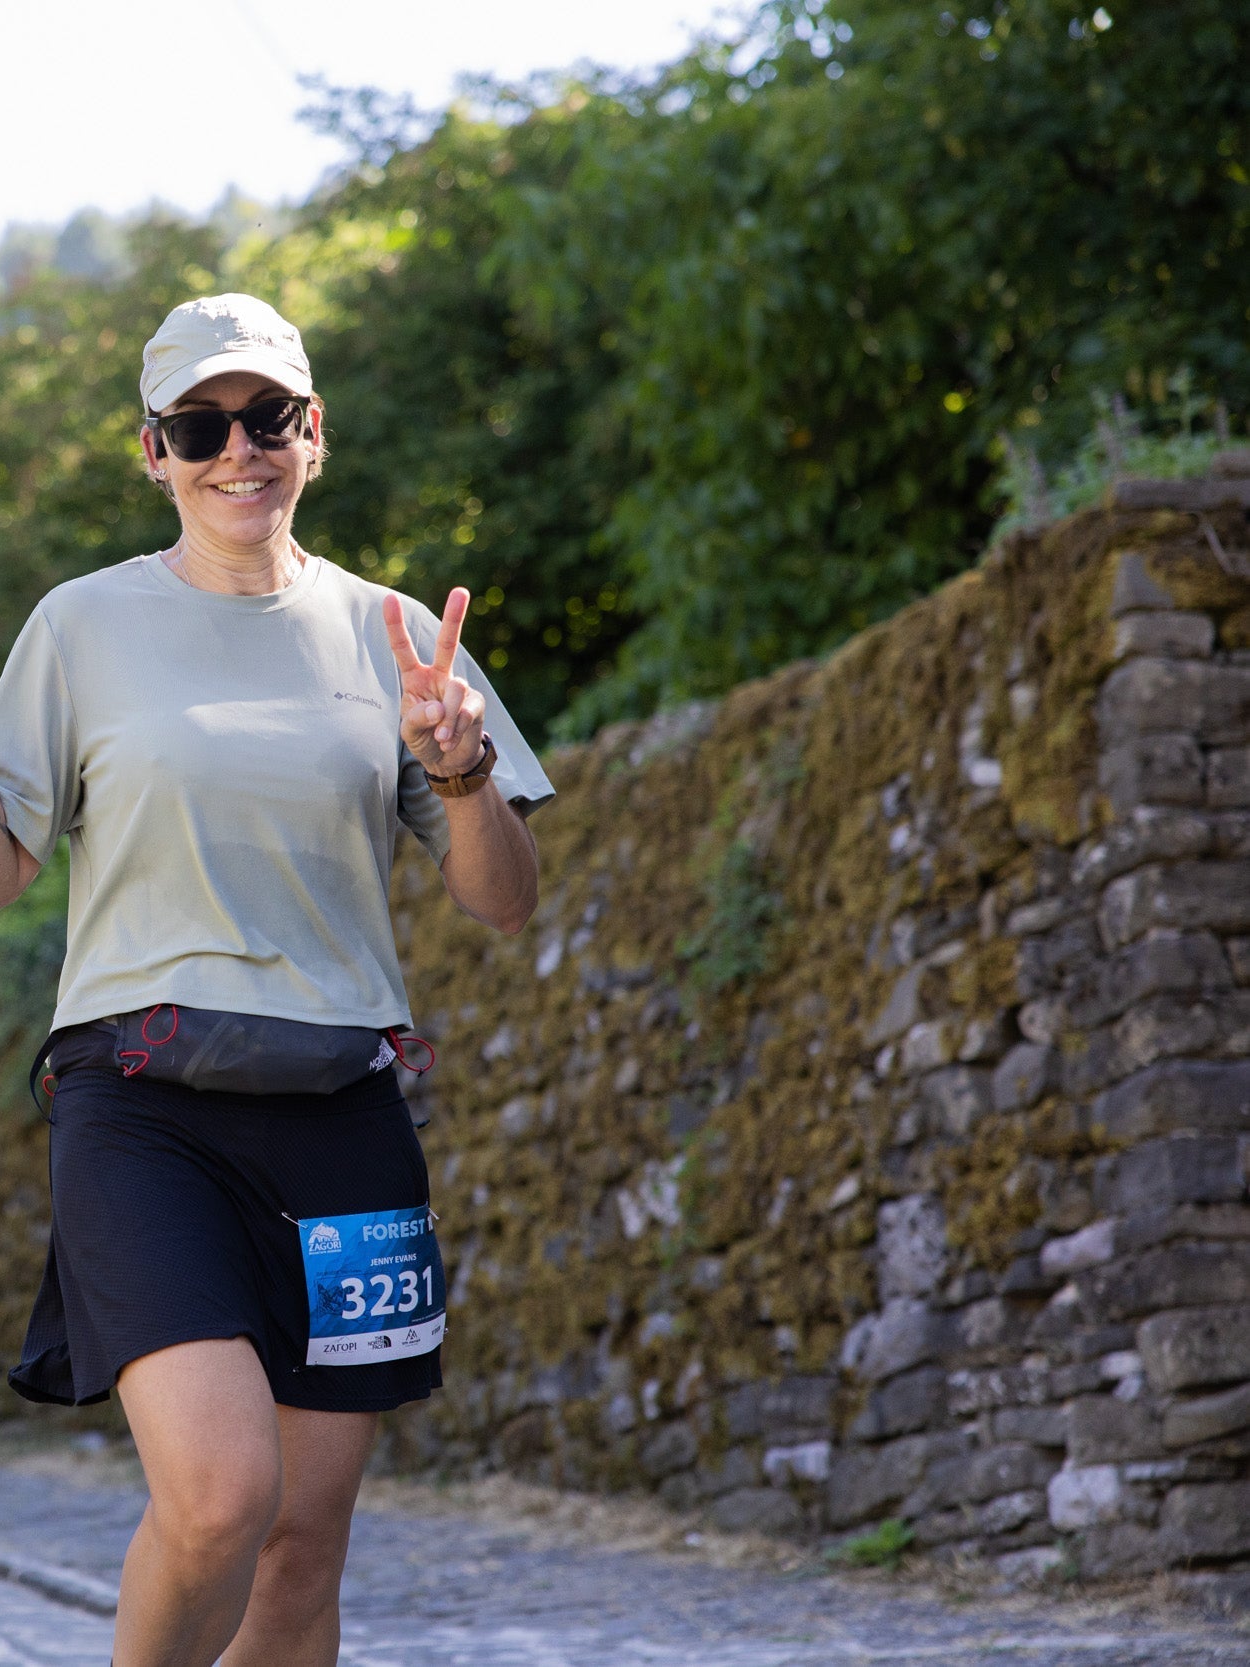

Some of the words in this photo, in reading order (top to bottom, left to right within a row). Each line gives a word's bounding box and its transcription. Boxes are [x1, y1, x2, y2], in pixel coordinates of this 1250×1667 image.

[344, 693, 382, 710] Columbia
[362, 1218, 425, 1242] FOREST
[370, 1256, 394, 1267] JENNY
[395, 1253, 417, 1264] EVANS
[341, 1265, 433, 1320] 3231
